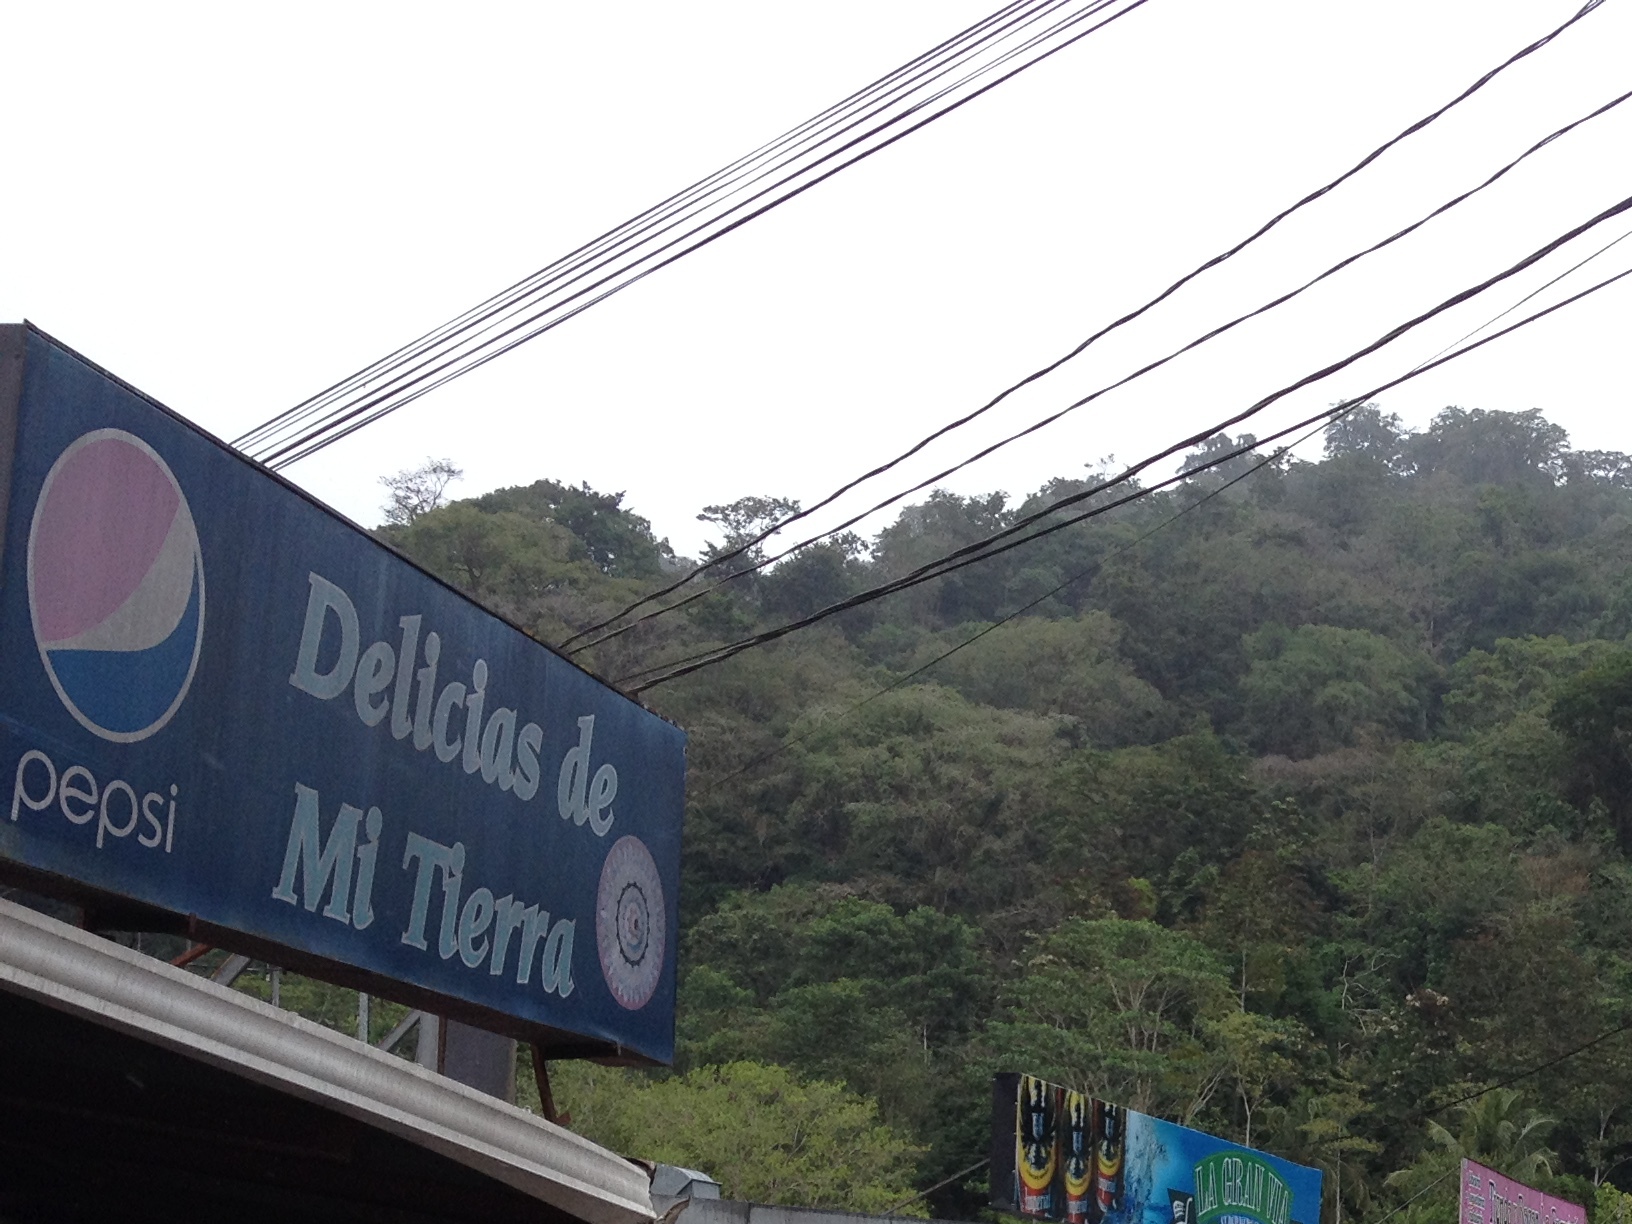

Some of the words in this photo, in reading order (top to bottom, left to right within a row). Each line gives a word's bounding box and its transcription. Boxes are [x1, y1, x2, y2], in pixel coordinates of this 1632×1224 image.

[289, 571, 544, 801] Delicias
[558, 714, 618, 836] de
[11, 750, 179, 853] pepsi
[272, 783, 384, 931] Mi
[402, 832, 576, 999] Tierra
[1195, 1162, 1218, 1217] LA
[1222, 1157, 1265, 1212] GRAN
